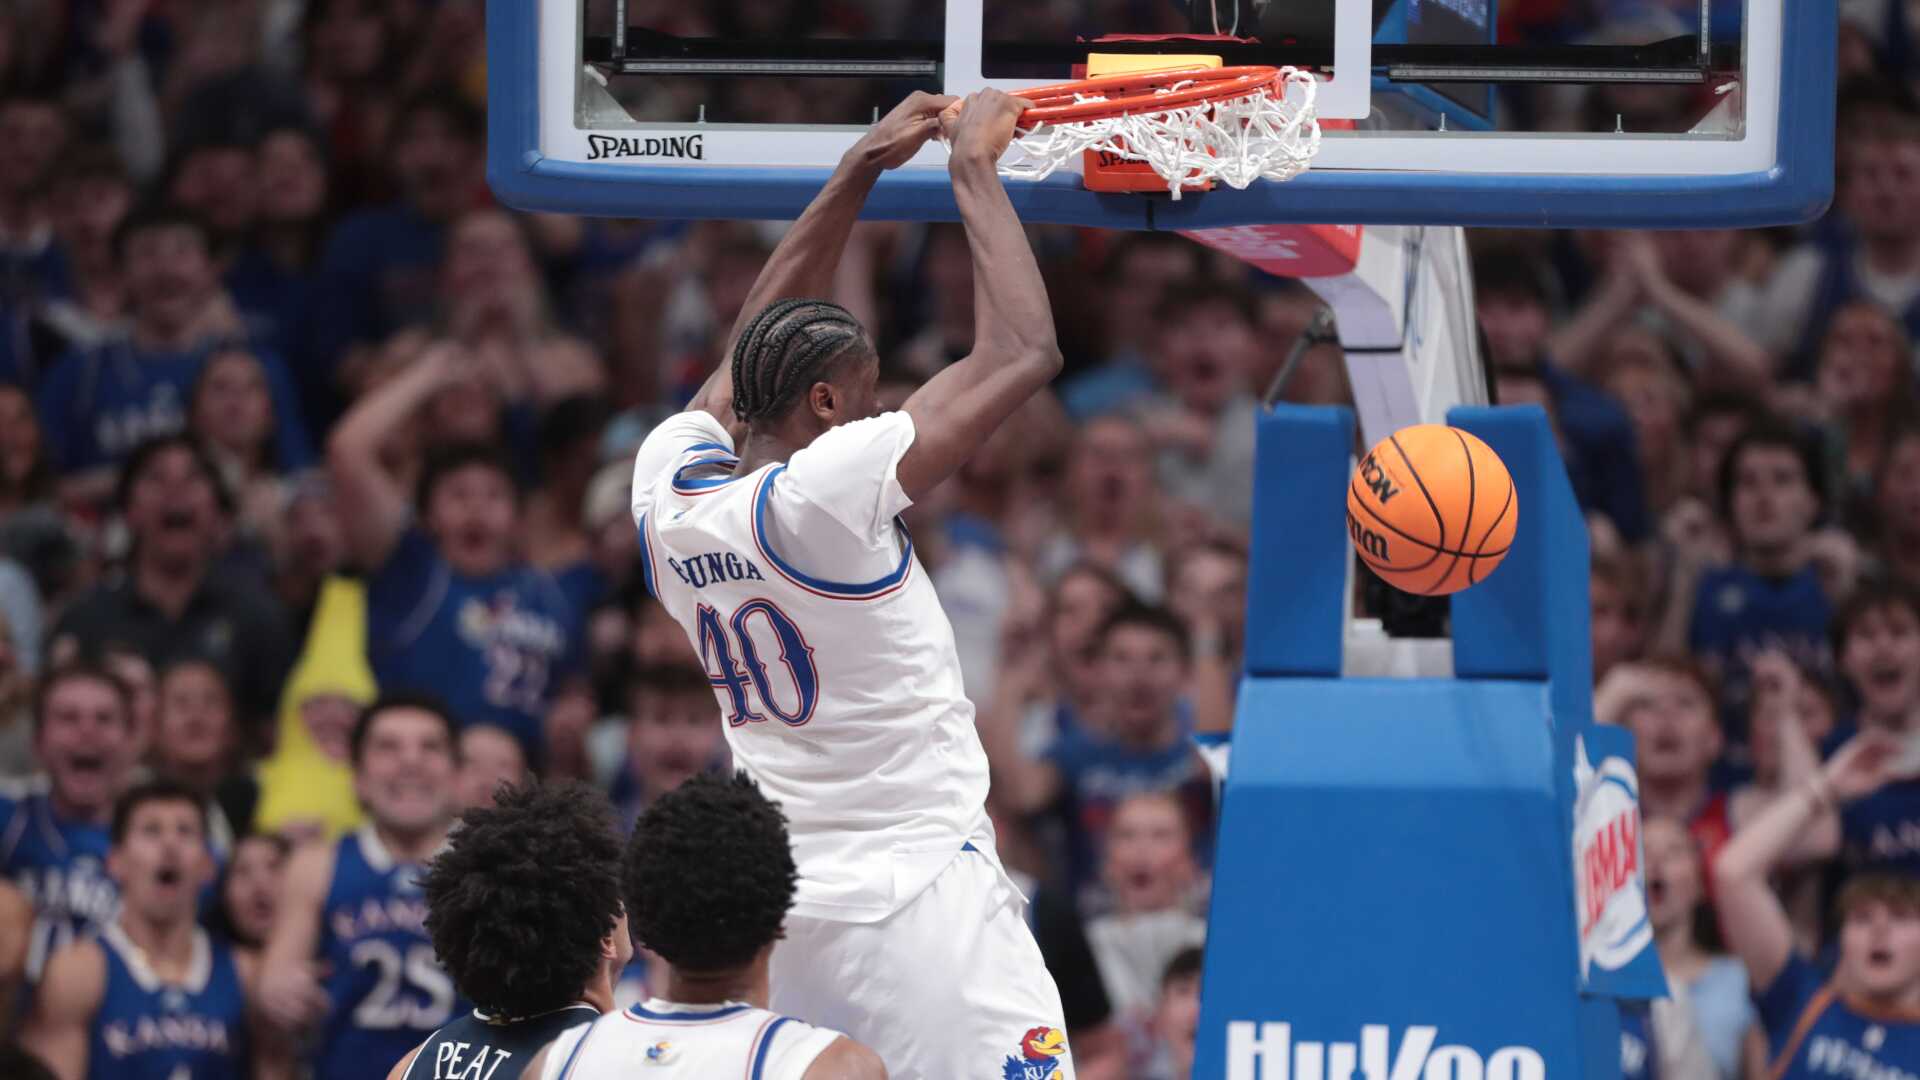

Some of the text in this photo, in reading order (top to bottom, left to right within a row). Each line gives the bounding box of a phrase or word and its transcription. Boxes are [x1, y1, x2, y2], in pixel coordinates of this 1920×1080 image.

[587, 134, 704, 160] SPALDING
[697, 598, 819, 727] 40
[350, 937, 456, 1031] 25
[434, 1041, 512, 1080] PEAT
[1024, 1066, 1045, 1080] KU
